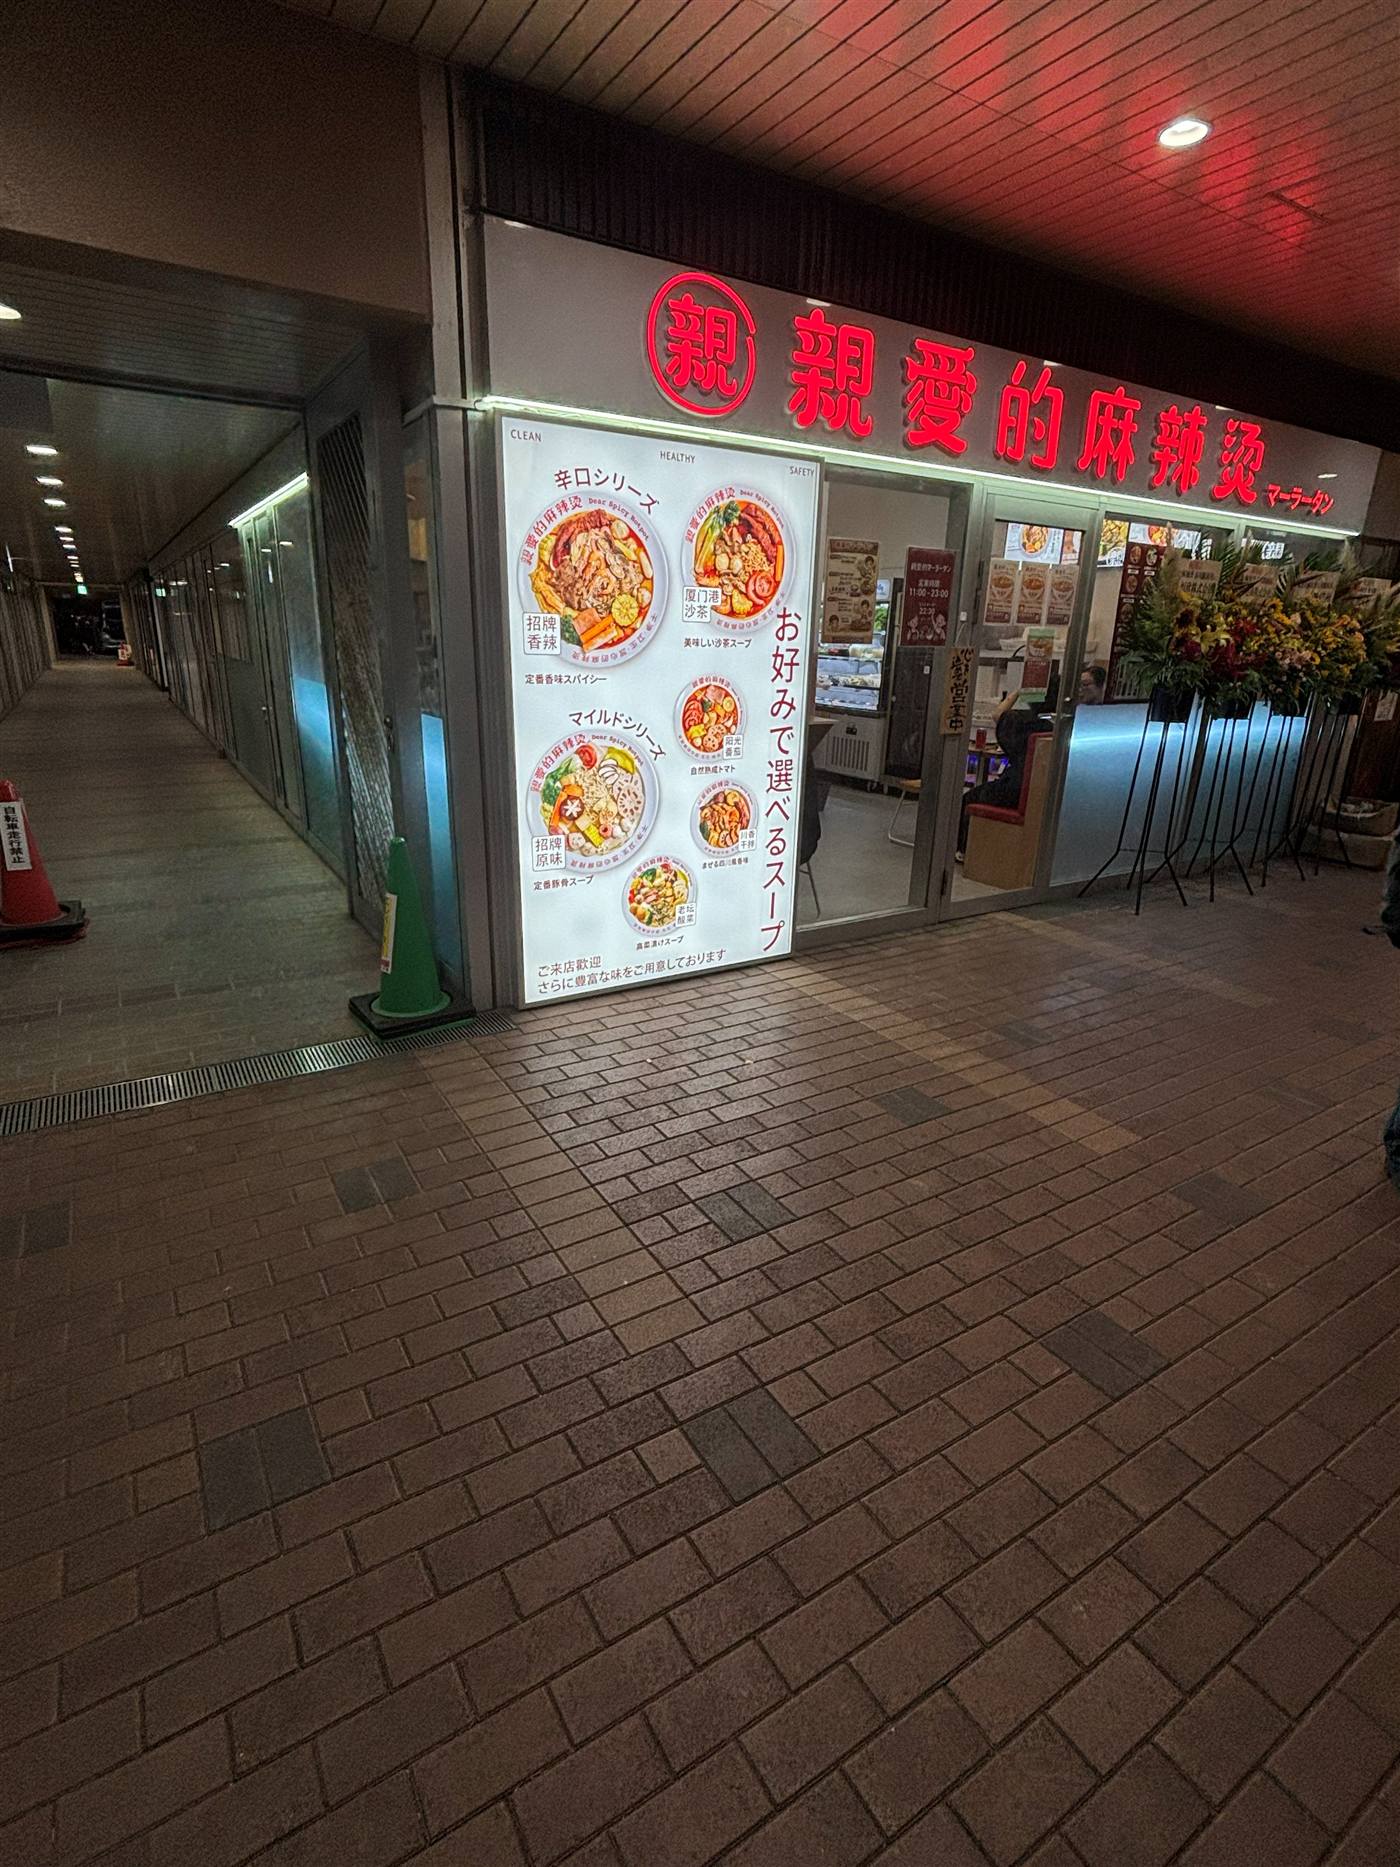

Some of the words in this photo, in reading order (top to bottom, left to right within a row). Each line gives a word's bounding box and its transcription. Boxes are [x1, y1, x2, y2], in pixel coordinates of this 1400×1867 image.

[666, 293, 738, 398] 親
[510, 429, 542, 443] CLEAN
[659, 450, 696, 465] HEALTHY
[789, 465, 815, 478] SAFETY
[554, 466, 660, 516] 辛口シリーズ
[1267, 484, 1334, 514] マーラータン
[684, 588, 720, 604] 厦门港
[684, 604, 708, 620] 沙茶
[526, 614, 558, 633] 招牌
[527, 633, 558, 651] 香辣
[683, 637, 752, 649] 美味しい沙茶スープ
[524, 672, 608, 686] 定番香味スパイシー
[568, 708, 667, 761] マイルドシリーズ
[760, 606, 802, 952] お好みで選べるスープ
[3, 805, 25, 864] 自転車走行禁止
[535, 837, 562, 853] 招牌
[535, 852, 563, 867] 原味
[533, 874, 594, 891] 定番豚骨スープ
[537, 948, 727, 994] さらに豊富な味をご用意しております
